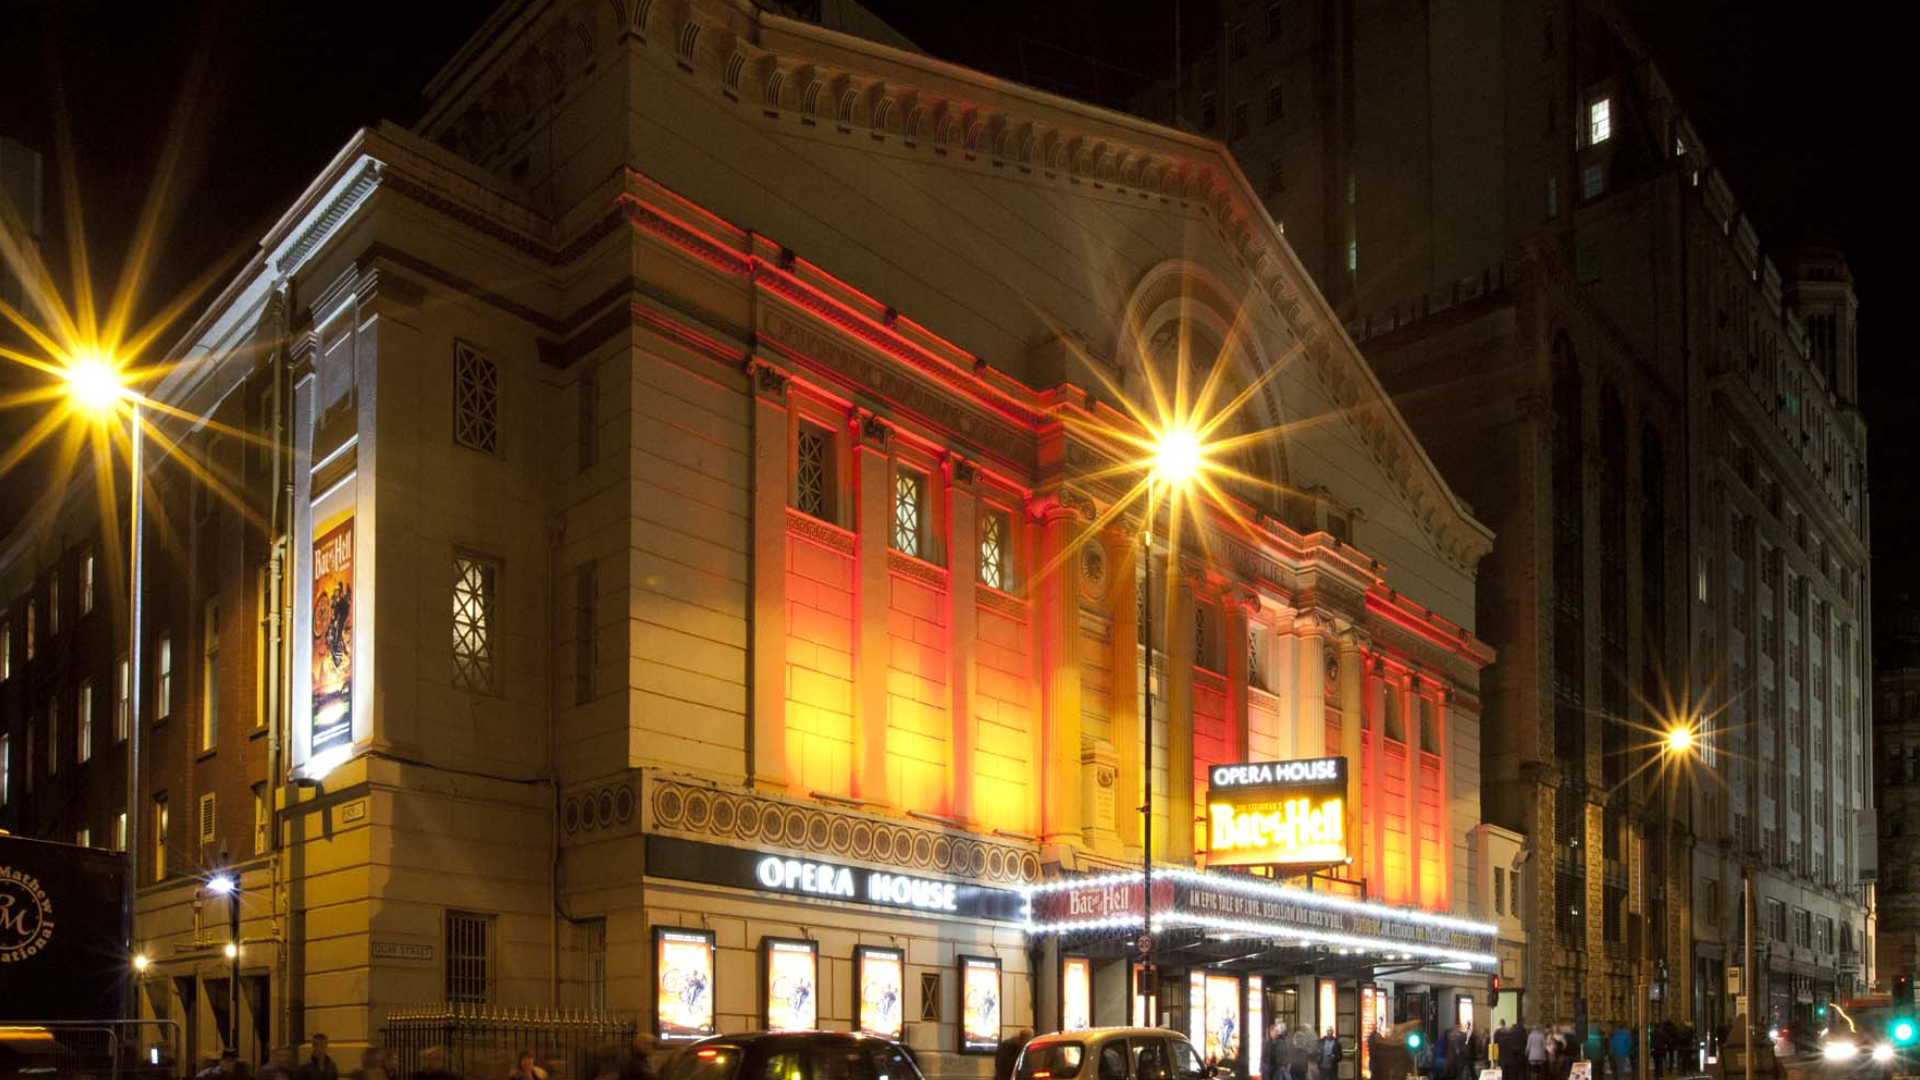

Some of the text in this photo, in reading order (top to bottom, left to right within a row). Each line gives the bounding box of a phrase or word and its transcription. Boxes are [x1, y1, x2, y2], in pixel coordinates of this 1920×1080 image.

[1214, 760, 1337, 785] OPERA HOUSE
[758, 857, 958, 911] OPERA HOUSE
[1103, 886, 1129, 916] Hell
[1190, 890, 1200, 907] AN
[1201, 891, 1217, 910] EPIC
[1218, 893, 1234, 912] TALE
[1140, 939, 1150, 948] 20
